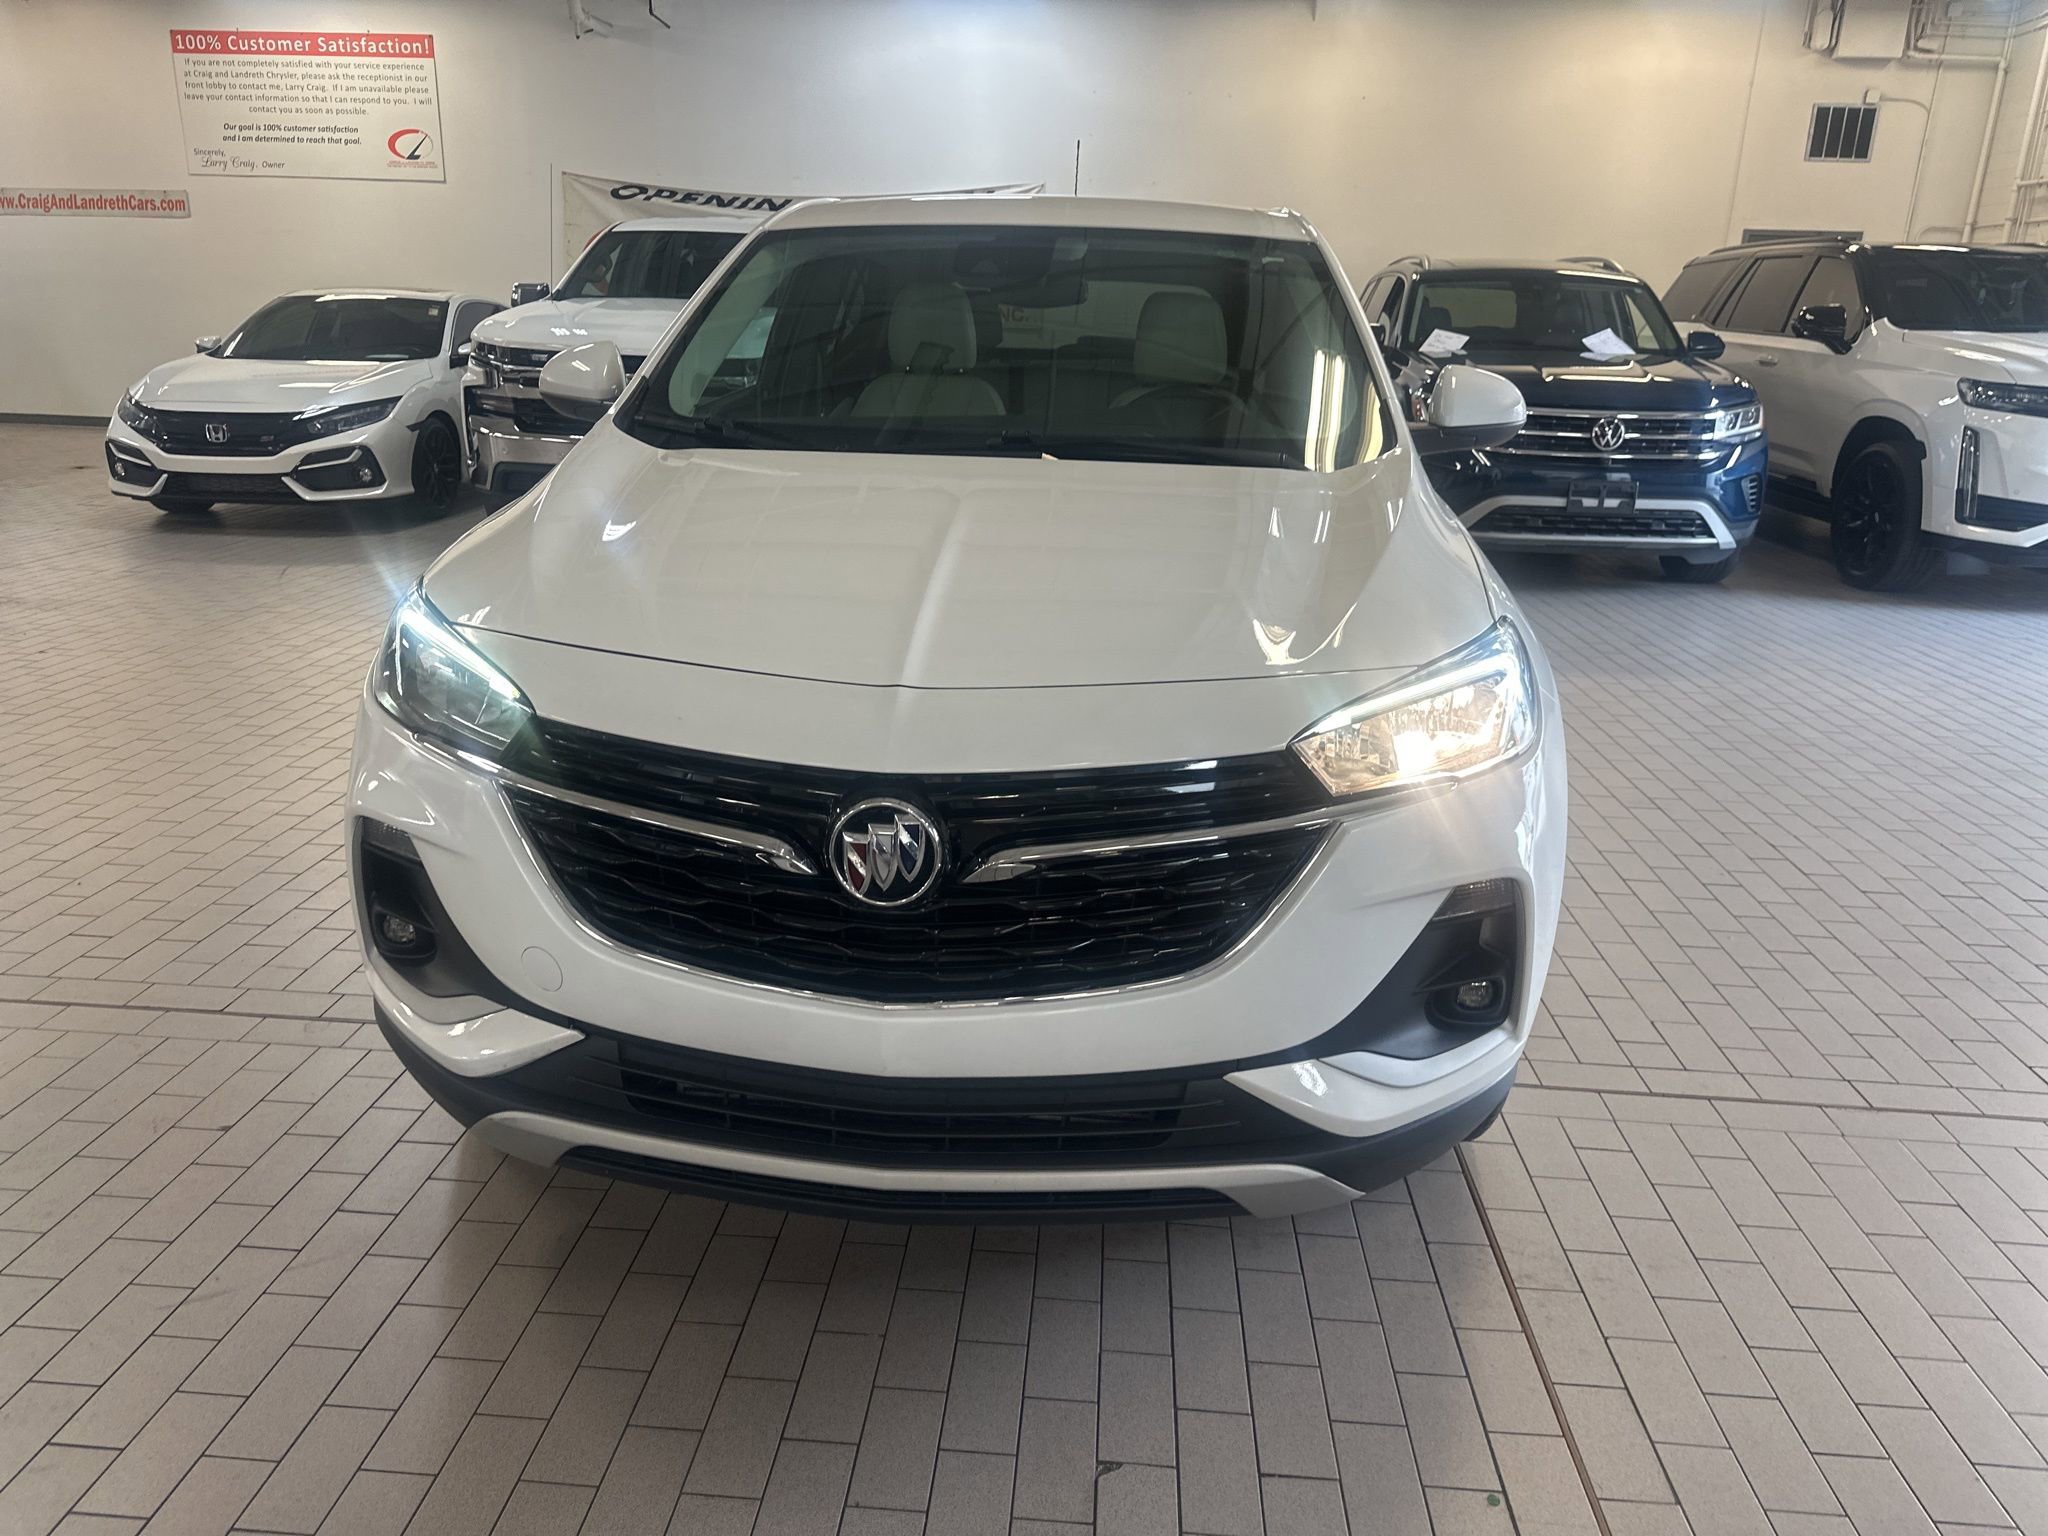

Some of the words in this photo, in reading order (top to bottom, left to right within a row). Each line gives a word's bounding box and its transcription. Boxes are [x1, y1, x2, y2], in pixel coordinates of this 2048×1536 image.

[175, 34, 220, 50] 100%
[227, 36, 311, 52] Customer
[318, 37, 429, 54] Satisfaction!
[237, 60, 278, 68] completely
[383, 63, 424, 71] experience
[194, 70, 212, 78] Craig
[266, 71, 299, 80] Chrysler,
[358, 73, 403, 82] receptionist
[206, 82, 226, 90] lobby
[285, 83, 304, 92] Larry
[307, 83, 328, 92] Craig.
[405, 85, 428, 94] please
[255, 93, 300, 102] information
[350, 96, 380, 105] respond
[318, 126, 358, 134] satisfaction
[344, 137, 361, 146] goal.
